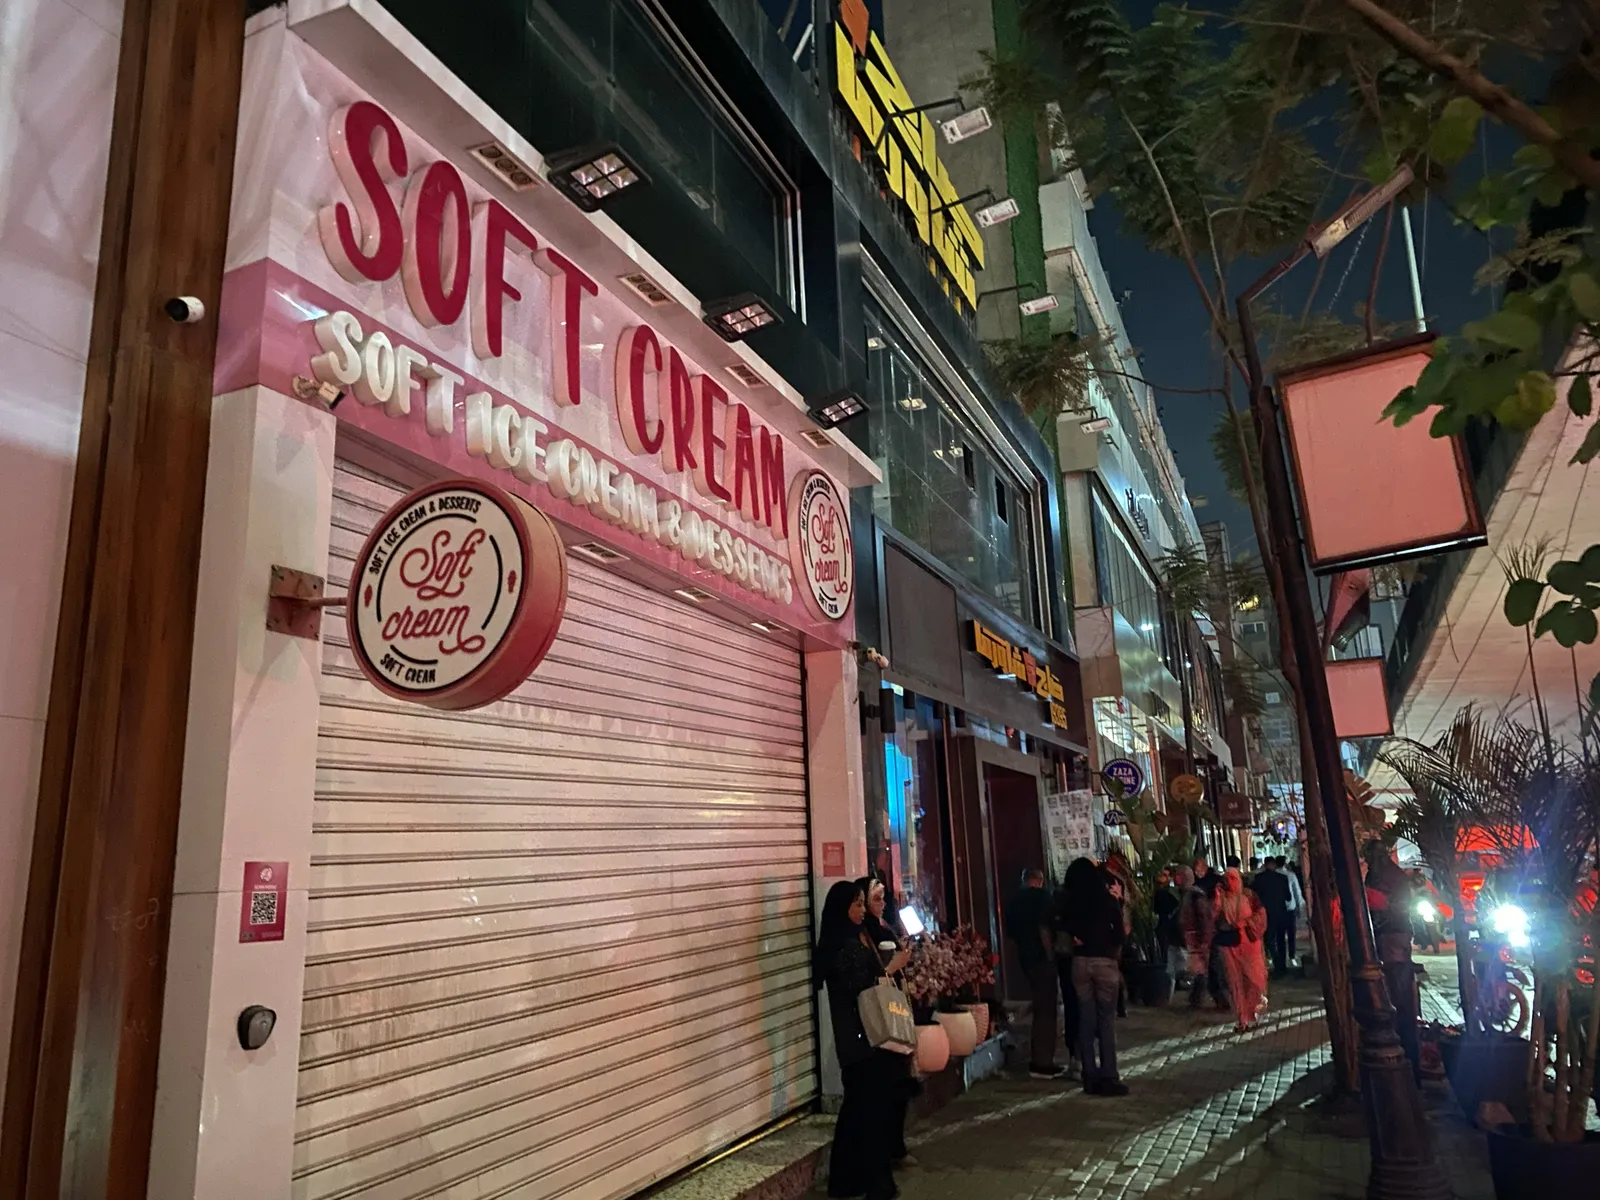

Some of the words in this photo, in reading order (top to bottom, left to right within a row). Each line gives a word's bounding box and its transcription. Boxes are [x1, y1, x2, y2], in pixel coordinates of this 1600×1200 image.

[324, 100, 599, 408] SOFT
[620, 323, 789, 541] CREAM
[311, 310, 465, 435] SOFT
[466, 391, 549, 482] ICE
[546, 438, 661, 542] CREAM
[658, 499, 684, 548] &
[368, 544, 388, 575] SOFT
[383, 527, 401, 547] ICE
[428, 500, 437, 513] &
[438, 496, 481, 514] DESSERTS
[811, 503, 836, 553] Soft
[399, 527, 486, 600] Soft
[814, 558, 848, 594] cream
[381, 604, 486, 656] cream
[380, 652, 405, 677] SOFT
[1112, 767, 1133, 776] ZAZA
